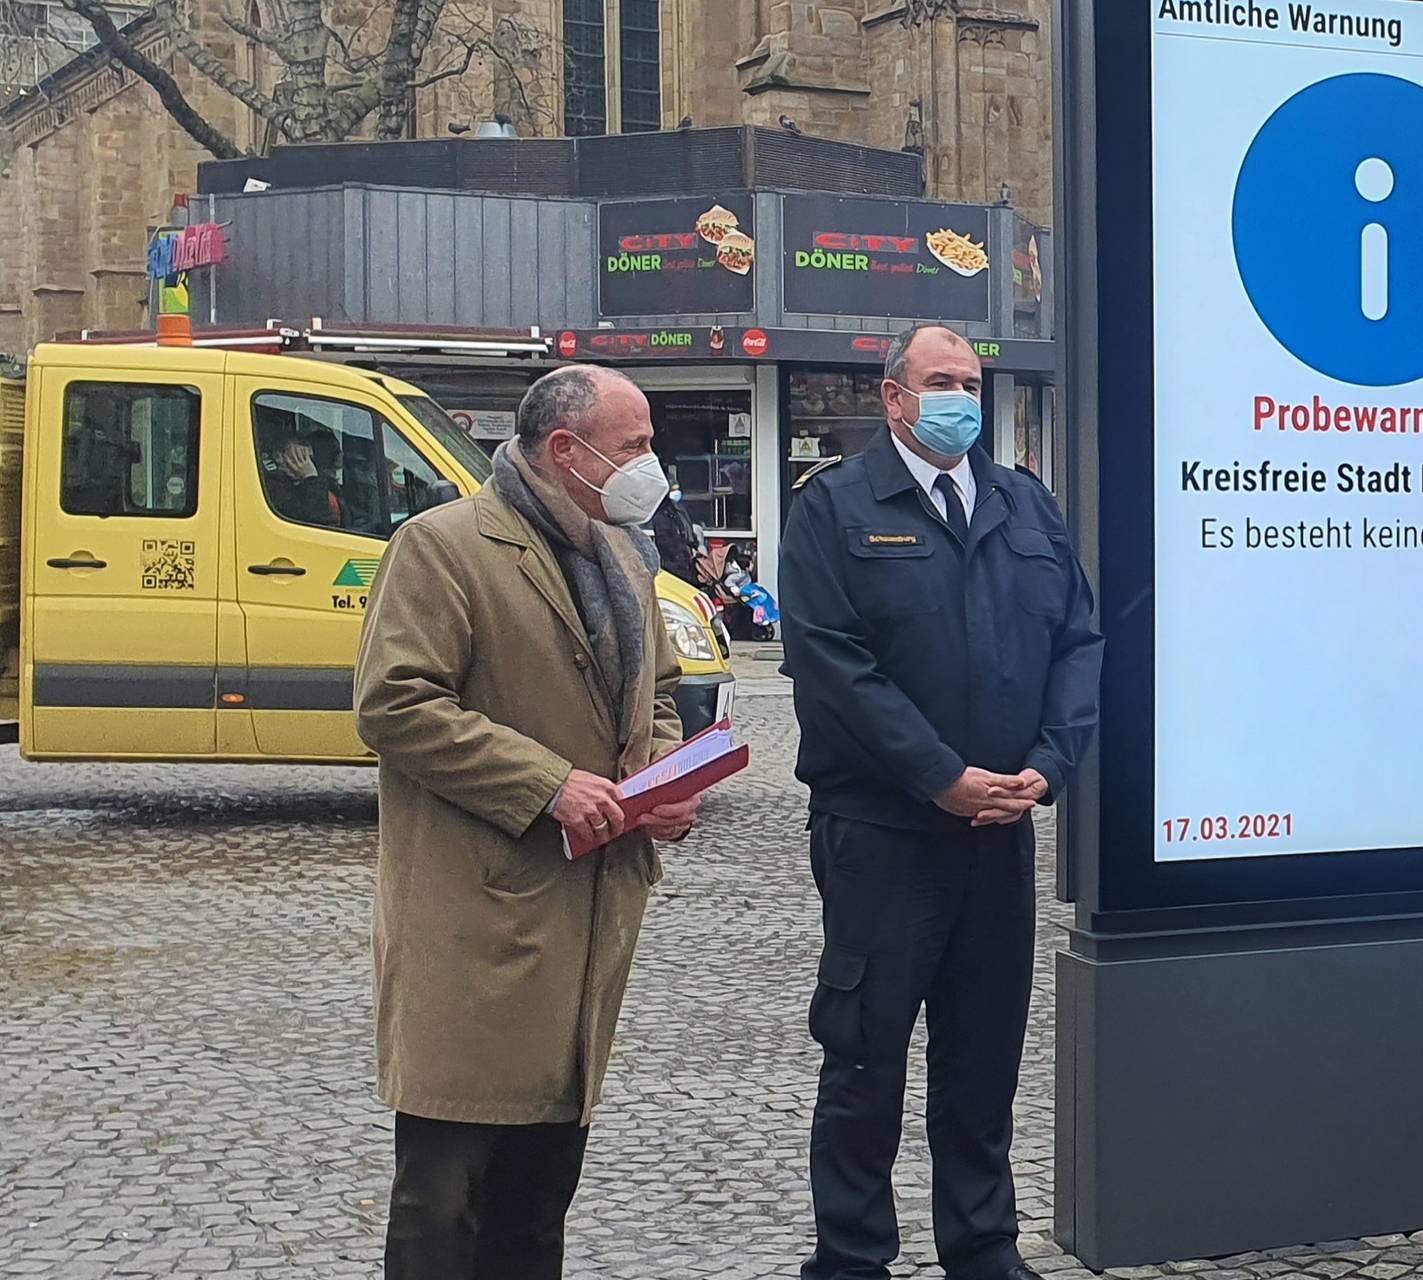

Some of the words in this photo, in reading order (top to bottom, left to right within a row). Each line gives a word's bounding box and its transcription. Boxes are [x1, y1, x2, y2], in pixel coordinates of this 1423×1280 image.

[1158, 0, 1279, 29] Amtliche
[1287, 3, 1402, 48] Warnung
[607, 252, 662, 272] DÖNER
[795, 248, 869, 271] DÖNER
[651, 331, 692, 346] DÖNER
[1181, 460, 1327, 493] Kreisfreie
[1336, 462, 1412, 493] Stadt
[1201, 518, 1234, 549] Es
[1246, 516, 1352, 549] besteht
[332, 595, 355, 609] Tel.
[1162, 813, 1293, 843] 17.03.2021
